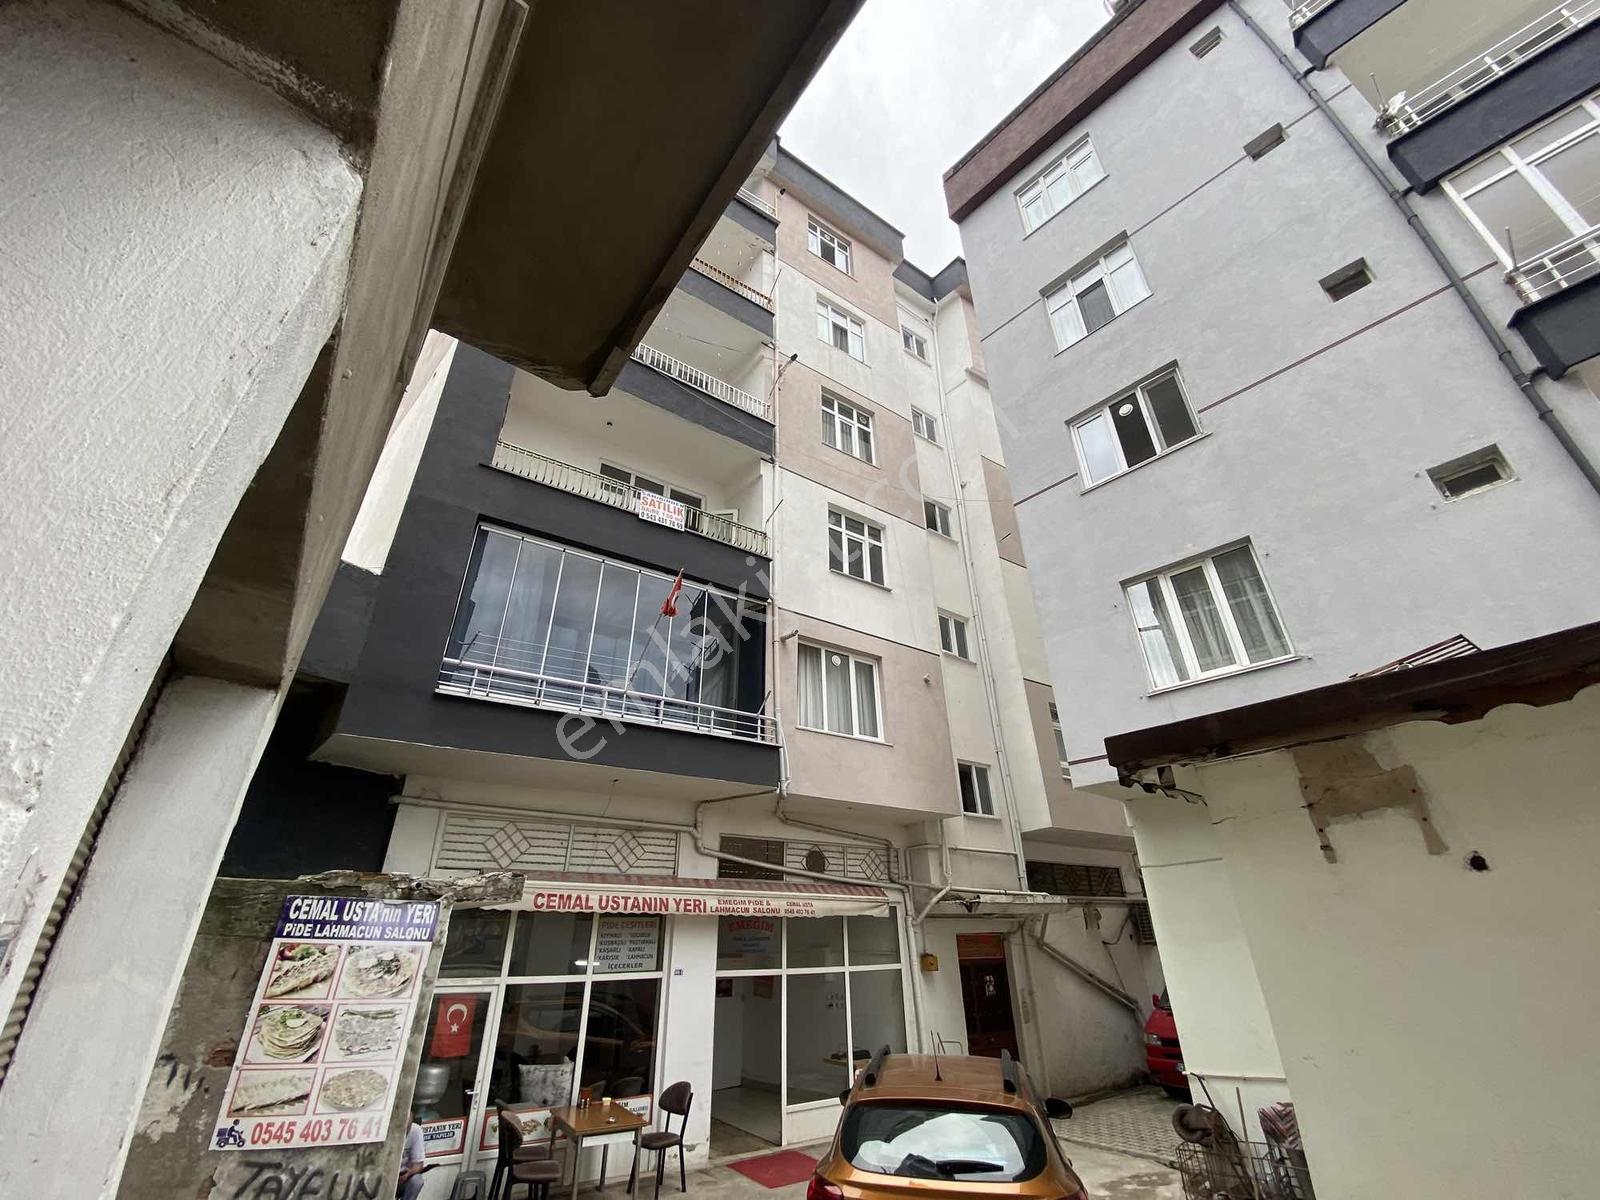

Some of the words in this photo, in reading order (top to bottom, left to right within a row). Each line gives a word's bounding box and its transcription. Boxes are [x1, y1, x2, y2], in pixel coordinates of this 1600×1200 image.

[641, 495, 685, 518] SATILIK
[289, 898, 340, 921] CEMAL
[533, 892, 594, 910] CEMAL
[598, 895, 670, 912] USTANIN
[710, 906, 750, 914] LAHMACUN
[314, 923, 382, 938] LAHMACUN
[383, 926, 431, 940] SALONU
[250, 1120, 297, 1145] 0545
[299, 1119, 333, 1143] 403
[337, 1117, 358, 1141] 76
[361, 1116, 384, 1139] 41
[233, 1160, 384, 1200] TAYFUN
